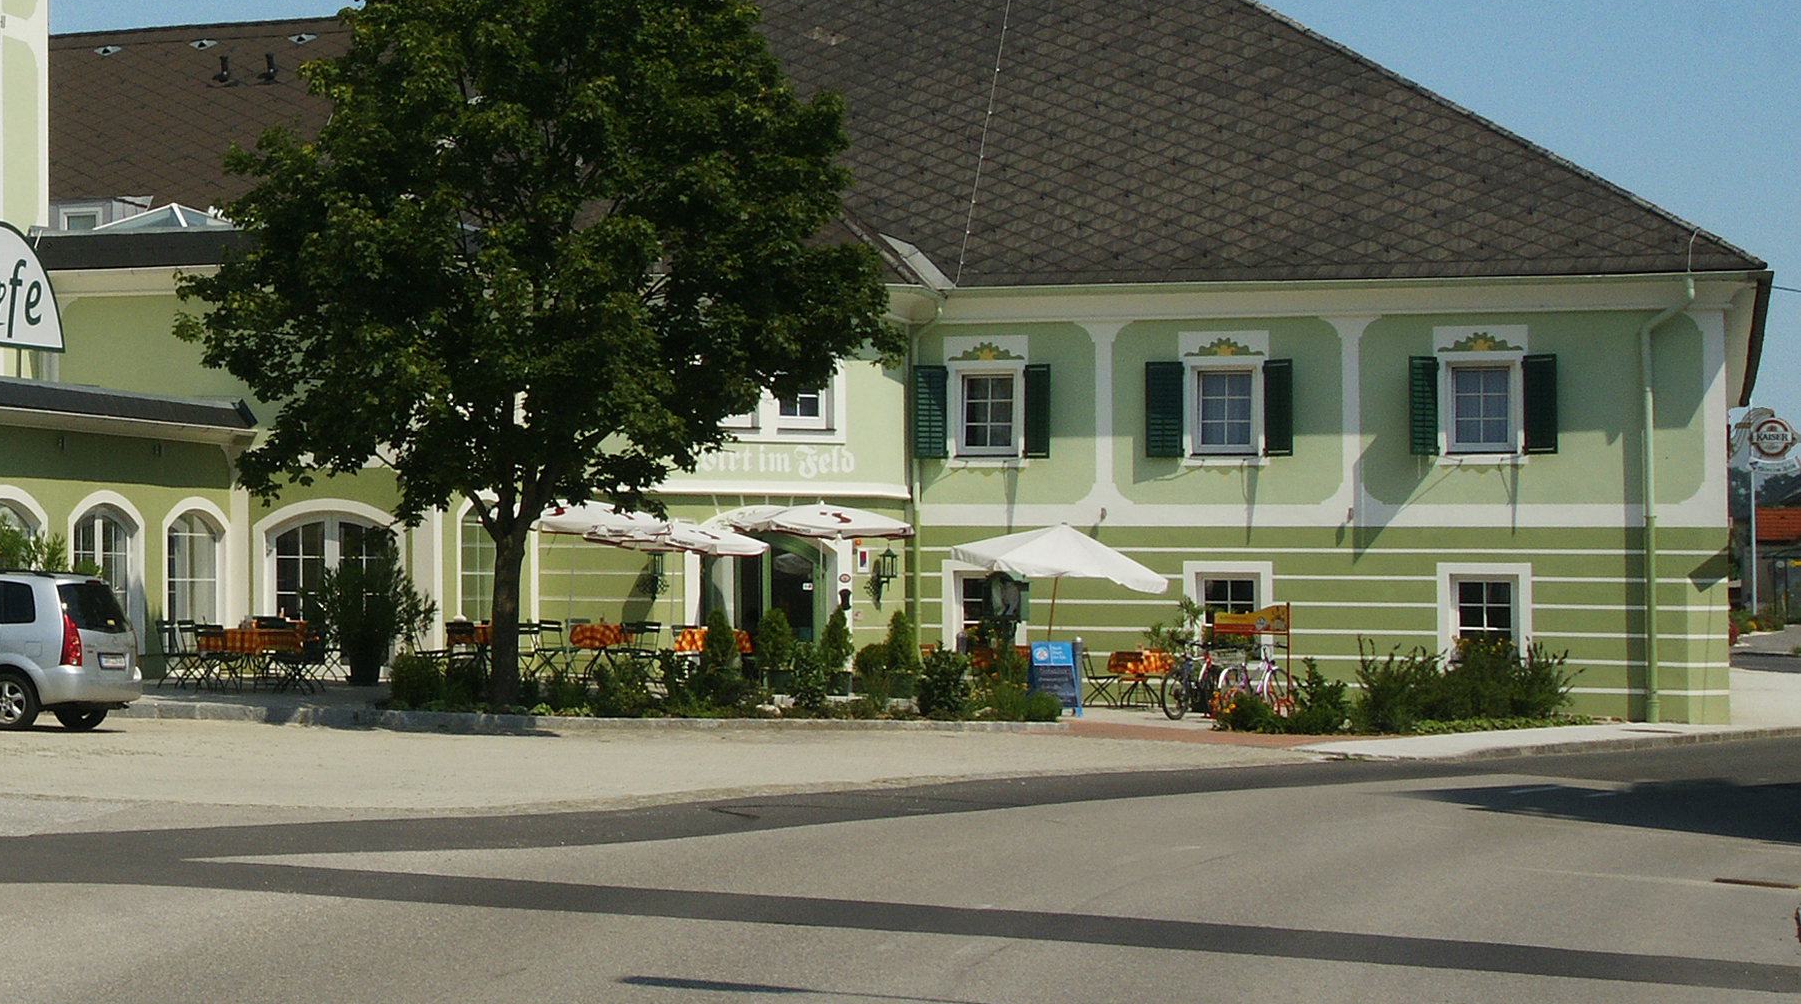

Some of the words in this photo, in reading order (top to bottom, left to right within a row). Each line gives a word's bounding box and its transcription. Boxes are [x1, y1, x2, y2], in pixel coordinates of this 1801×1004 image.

[1755, 432, 1789, 442] KAISER
[759, 444, 792, 473] im
[794, 444, 855, 479] Feld
